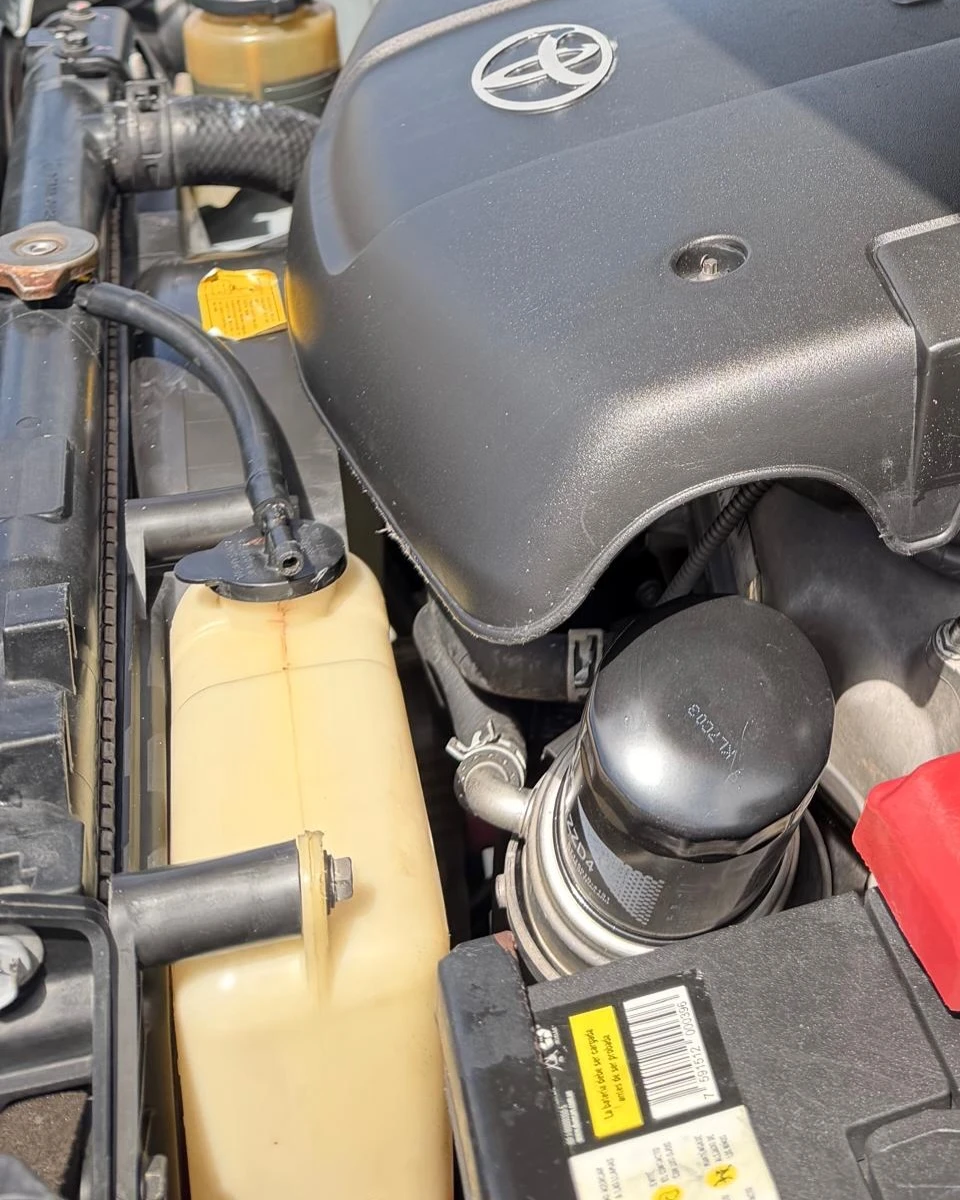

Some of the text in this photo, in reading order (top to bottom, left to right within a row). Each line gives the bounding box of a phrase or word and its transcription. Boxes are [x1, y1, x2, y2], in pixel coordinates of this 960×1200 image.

[677, 1001, 715, 1100] 7 591512 000396
